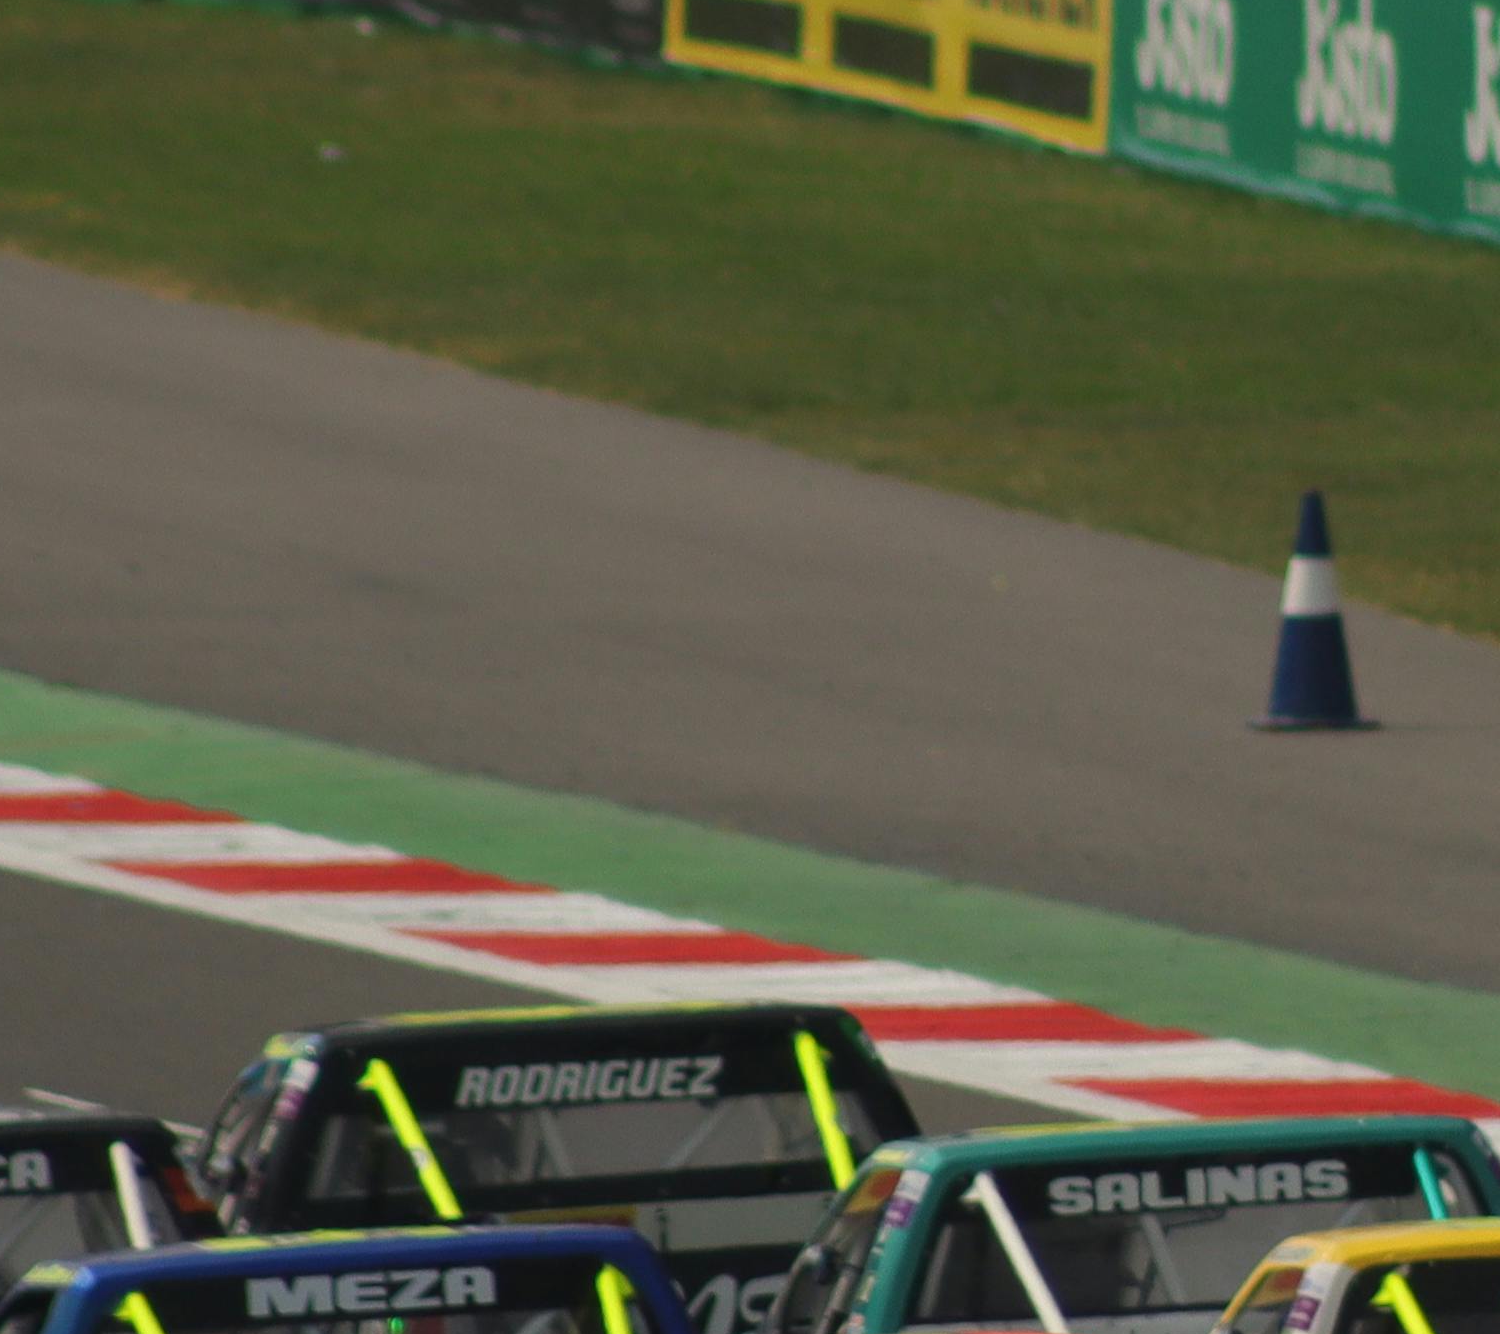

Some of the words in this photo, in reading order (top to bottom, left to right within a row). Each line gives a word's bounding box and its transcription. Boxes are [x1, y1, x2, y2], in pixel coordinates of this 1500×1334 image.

[455, 1055, 723, 1108] RODRIGUEZ
[1049, 1160, 1350, 1216] SALINAS
[246, 1266, 497, 1319] MEZA
